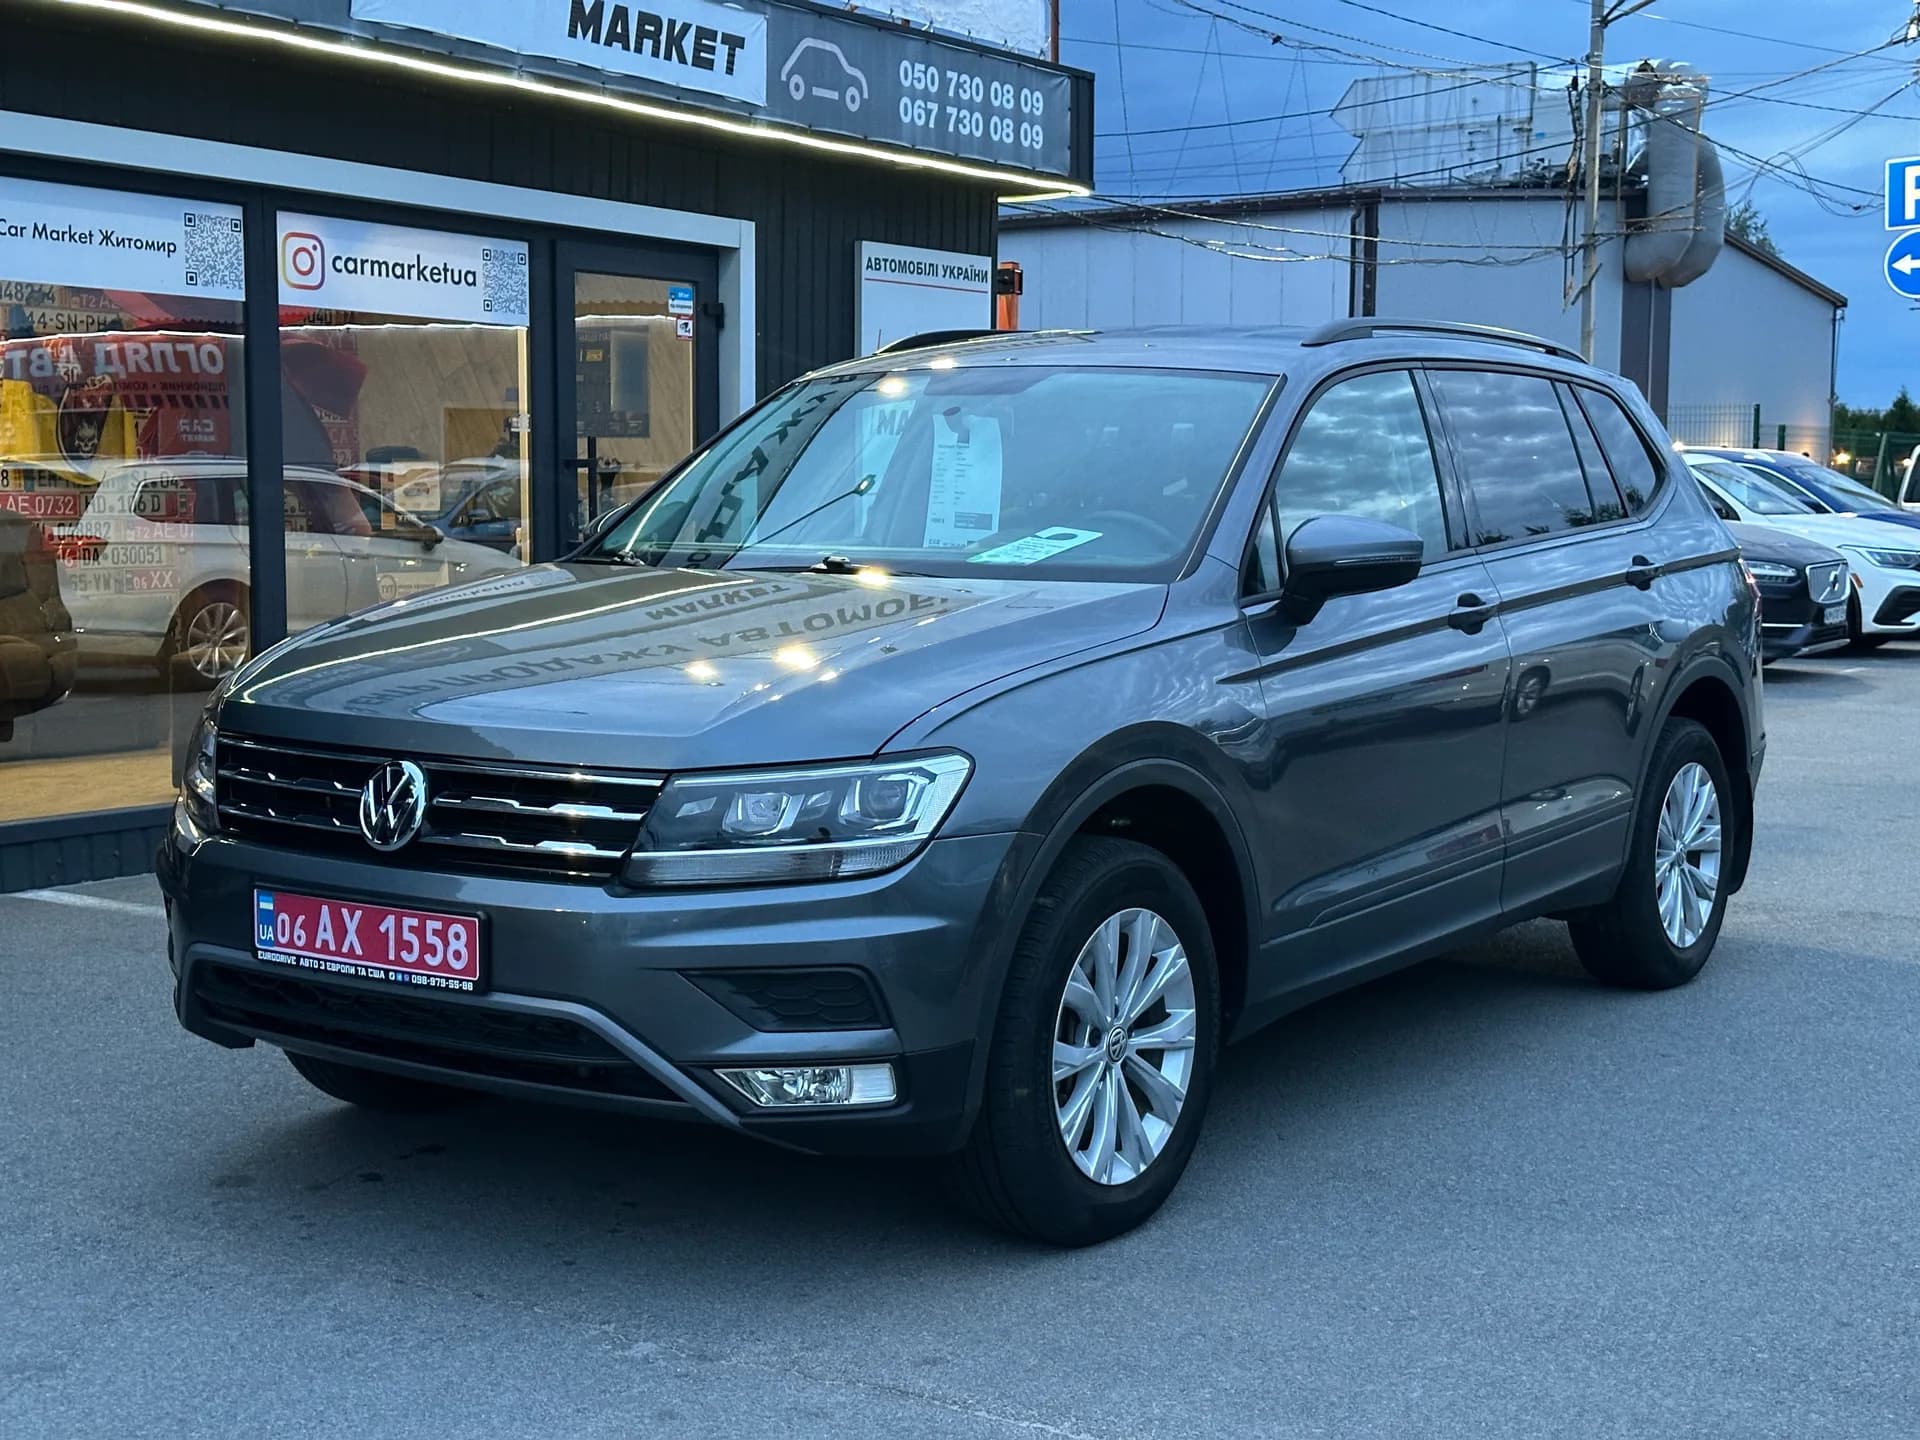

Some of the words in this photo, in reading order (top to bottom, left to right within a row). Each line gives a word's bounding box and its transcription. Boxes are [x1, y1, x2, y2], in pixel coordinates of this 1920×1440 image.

[567, 0, 746, 76] MARKET
[899, 60, 939, 93] 050
[946, 70, 984, 103] 730
[990, 81, 1015, 109] 08
[1020, 88, 1044, 116] 09
[899, 96, 939, 128] 067
[946, 106, 984, 137] 730
[989, 115, 1015, 143] 08
[1020, 122, 1044, 149] 09
[0, 218, 27, 238] Car
[32, 222, 94, 245] Market
[98, 229, 177, 258] Житомир
[331, 254, 477, 287] carmarketua
[866, 256, 939, 278] АВТОМОБІЛІ
[941, 264, 989, 284] УКРАЇНИ
[35, 496, 74, 515] 0732
[258, 924, 274, 942] UA
[276, 912, 307, 947] 06
[315, 904, 363, 956] AX
[378, 913, 469, 971] 1558
[257, 950, 297, 965] EURODRIVE
[299, 957, 318, 969] АВТО
[356, 966, 366, 976] ТА
[368, 968, 385, 979] США
